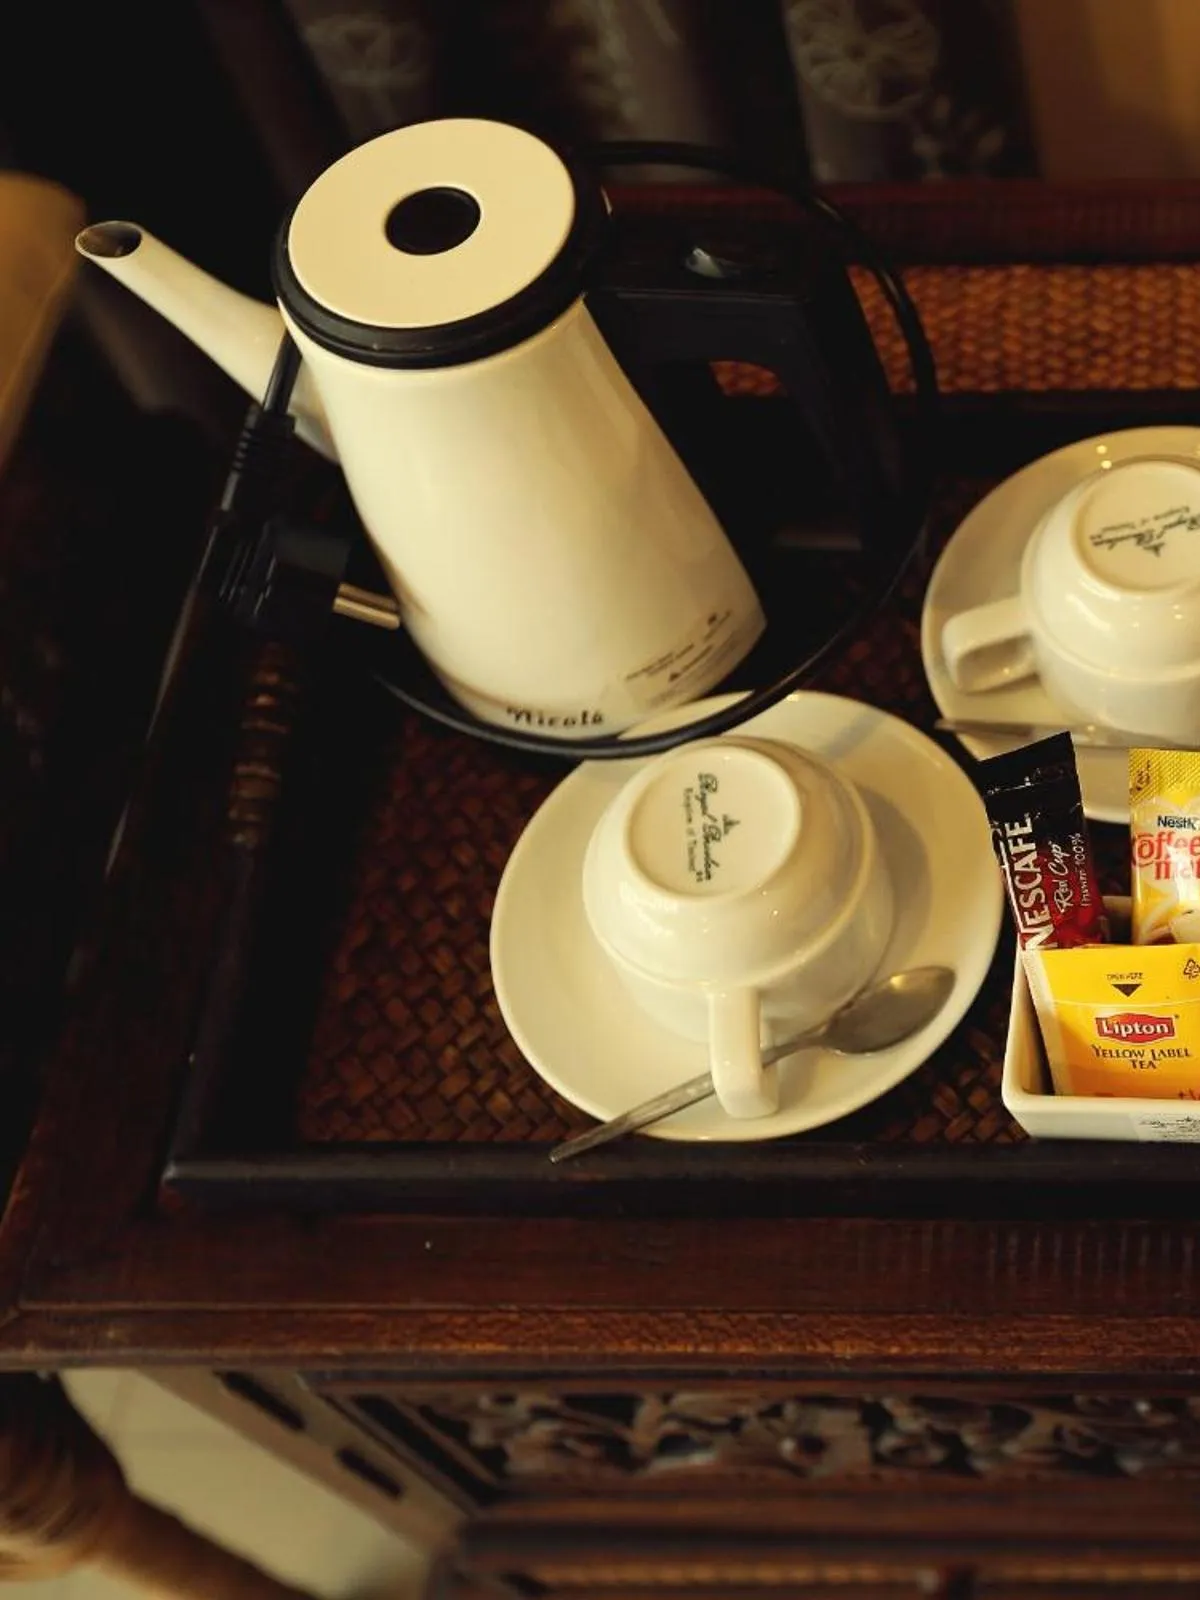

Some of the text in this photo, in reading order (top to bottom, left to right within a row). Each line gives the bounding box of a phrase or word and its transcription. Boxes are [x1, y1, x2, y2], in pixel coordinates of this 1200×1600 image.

[1048, 842, 1071, 876] Cup
[1101, 1019, 1169, 1038] Lipton
[1092, 1044, 1191, 1061] YELLOW LABEL
[1130, 1060, 1156, 1069] TEA
